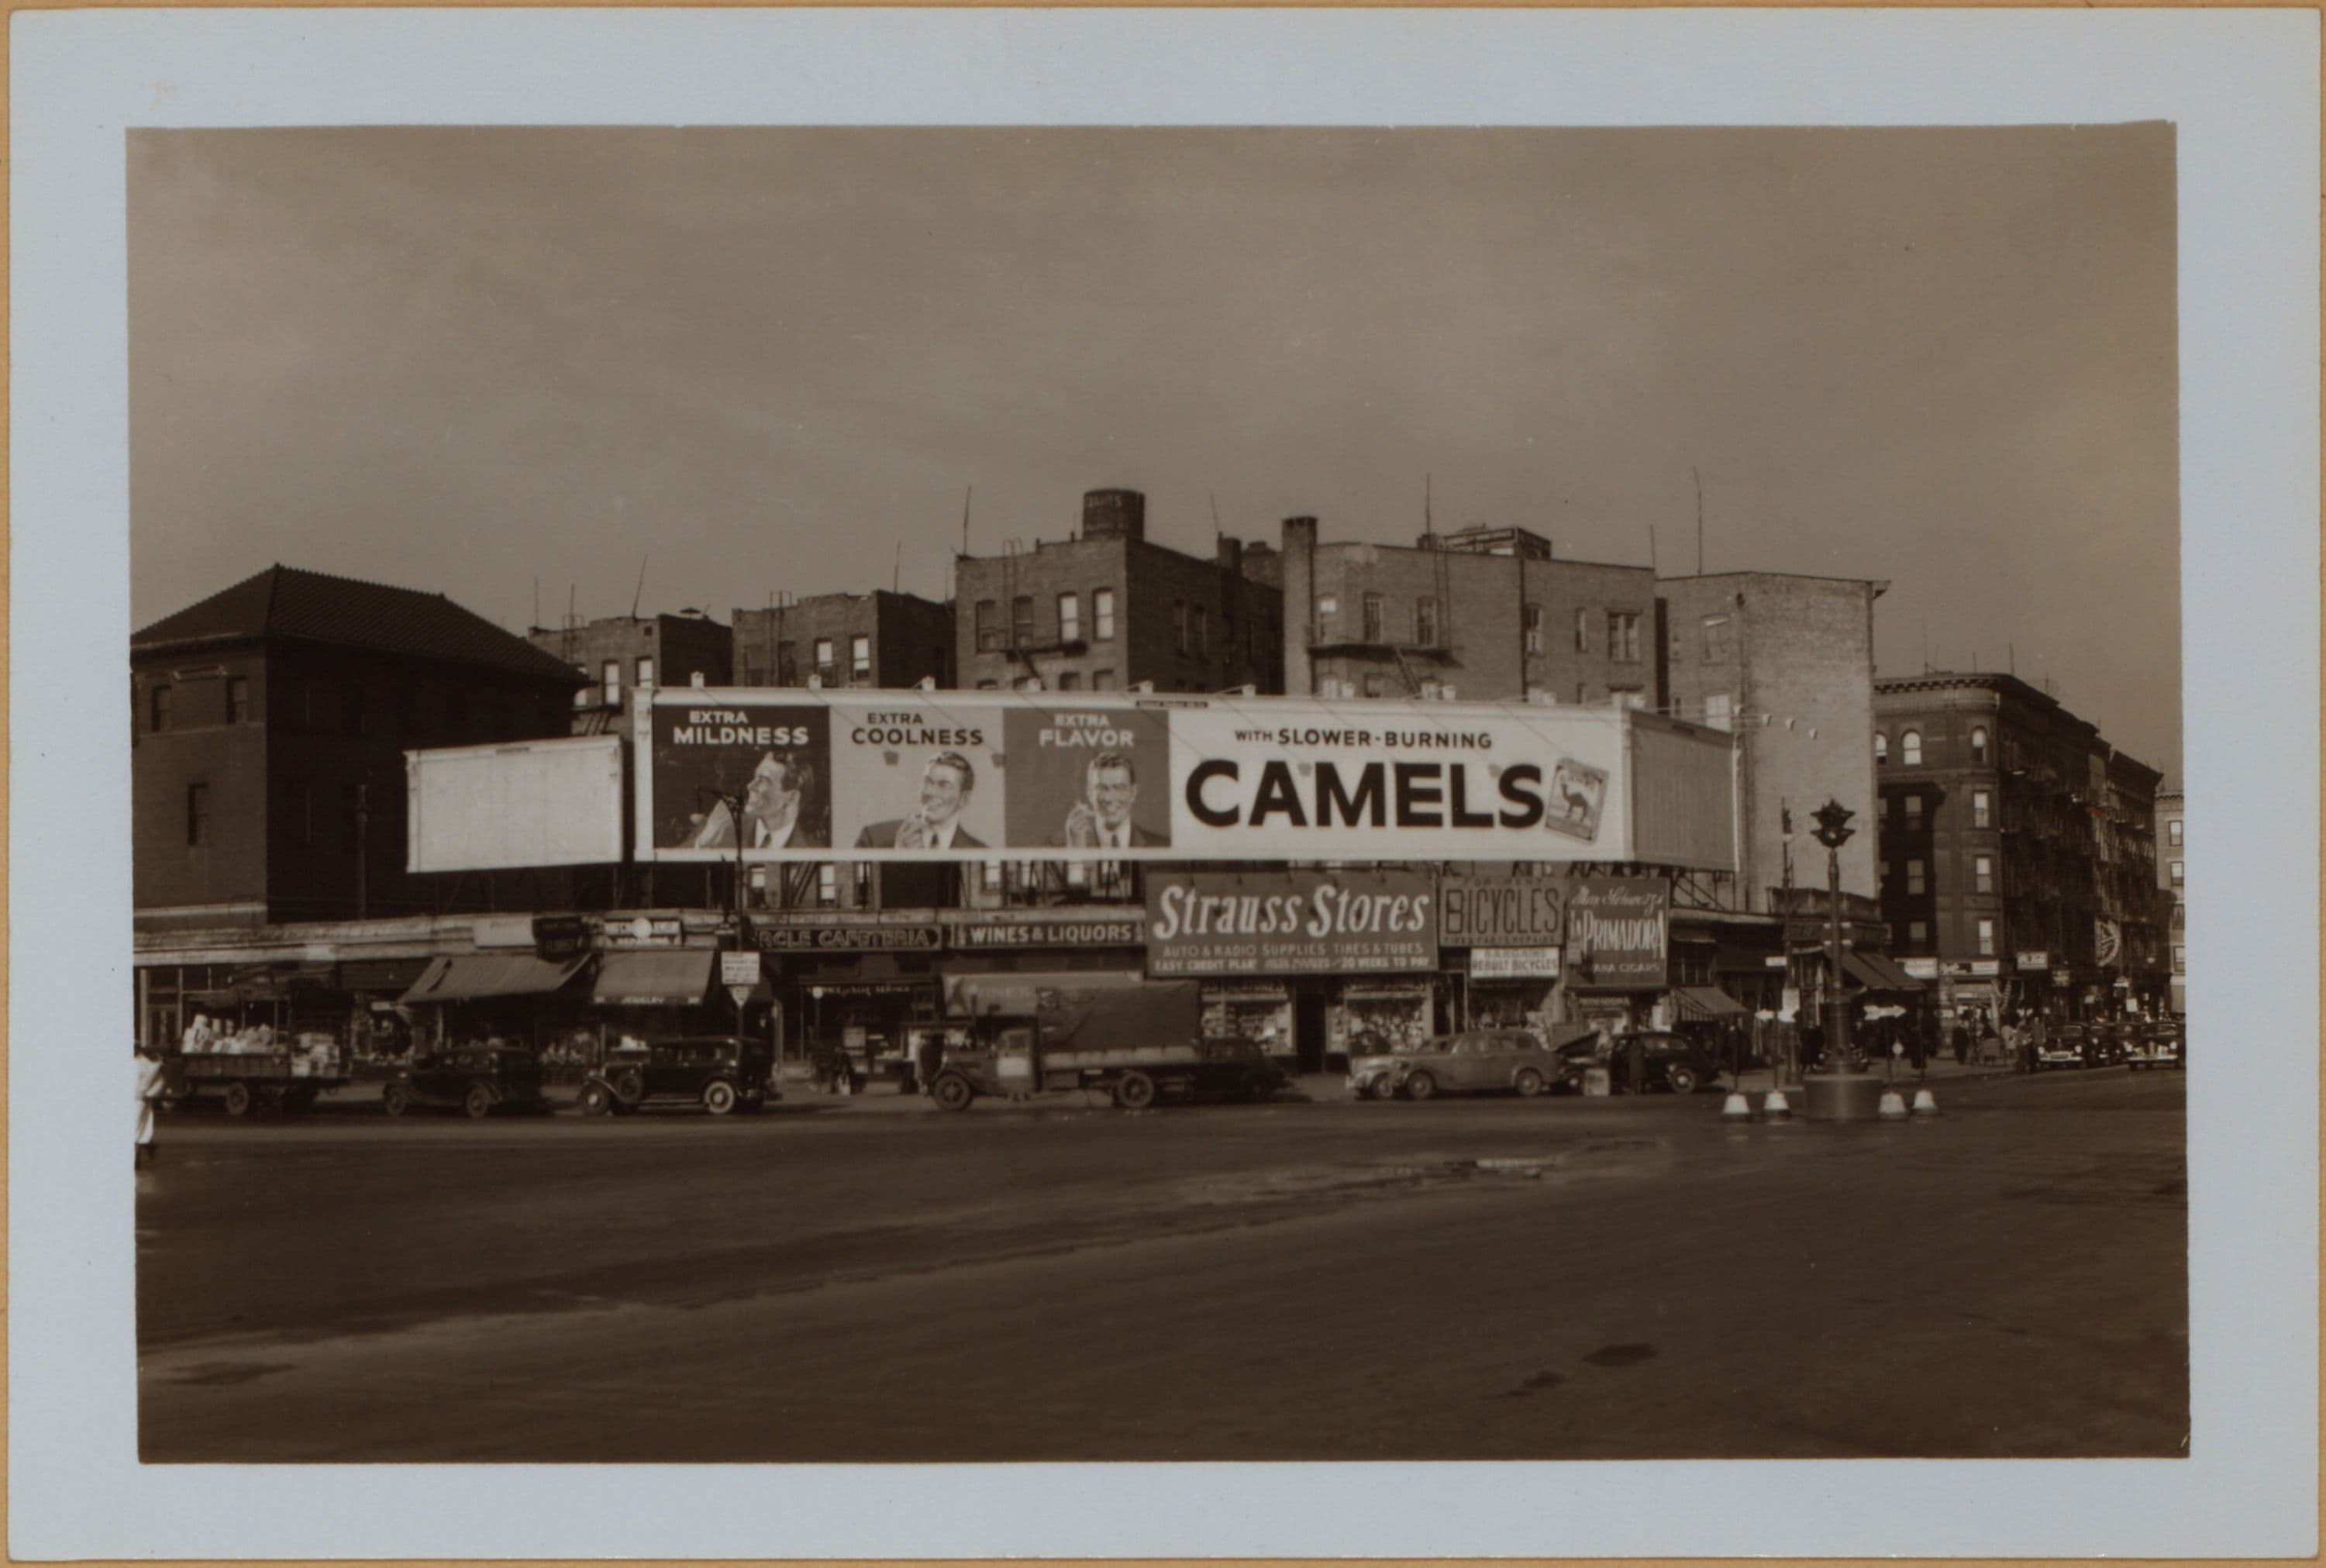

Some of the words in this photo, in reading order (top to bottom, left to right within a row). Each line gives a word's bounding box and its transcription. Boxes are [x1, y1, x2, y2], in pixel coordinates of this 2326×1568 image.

[689, 711, 749, 725] EXTRA
[867, 713, 924, 725] EXTRA
[1055, 714, 1110, 727] EXTRA
[673, 727, 809, 746] MILDNESS
[851, 728, 984, 746] COOLNESS
[1039, 729, 1134, 748] FLAVOR
[1235, 729, 1273, 742] WITH
[1278, 728, 1493, 749] SLOWER-BURNING
[1185, 758, 1545, 828] CAMELS
[1153, 885, 1303, 939] Strauss
[1307, 885, 1429, 938] Stores
[1446, 888, 1559, 934] BICYCLES
[759, 929, 812, 948] RCLE
[818, 929, 930, 947] CAFETERIA
[970, 926, 1028, 943] WINES
[1030, 927, 1044, 941] &
[1046, 925, 1132, 942] LIQUORS
[1583, 909, 1666, 959] PRIMADORA
[1163, 945, 1198, 957] AUTO
[1214, 944, 1256, 956] RADIO
[1262, 943, 1325, 956] SUPPLIES
[1332, 943, 1370, 956] TIRES
[1384, 942, 1424, 954] TUBES
[1154, 960, 1184, 971] EASY
[1392, 956, 1407, 967] TO
[1512, 959, 1558, 970] BICYCLES
